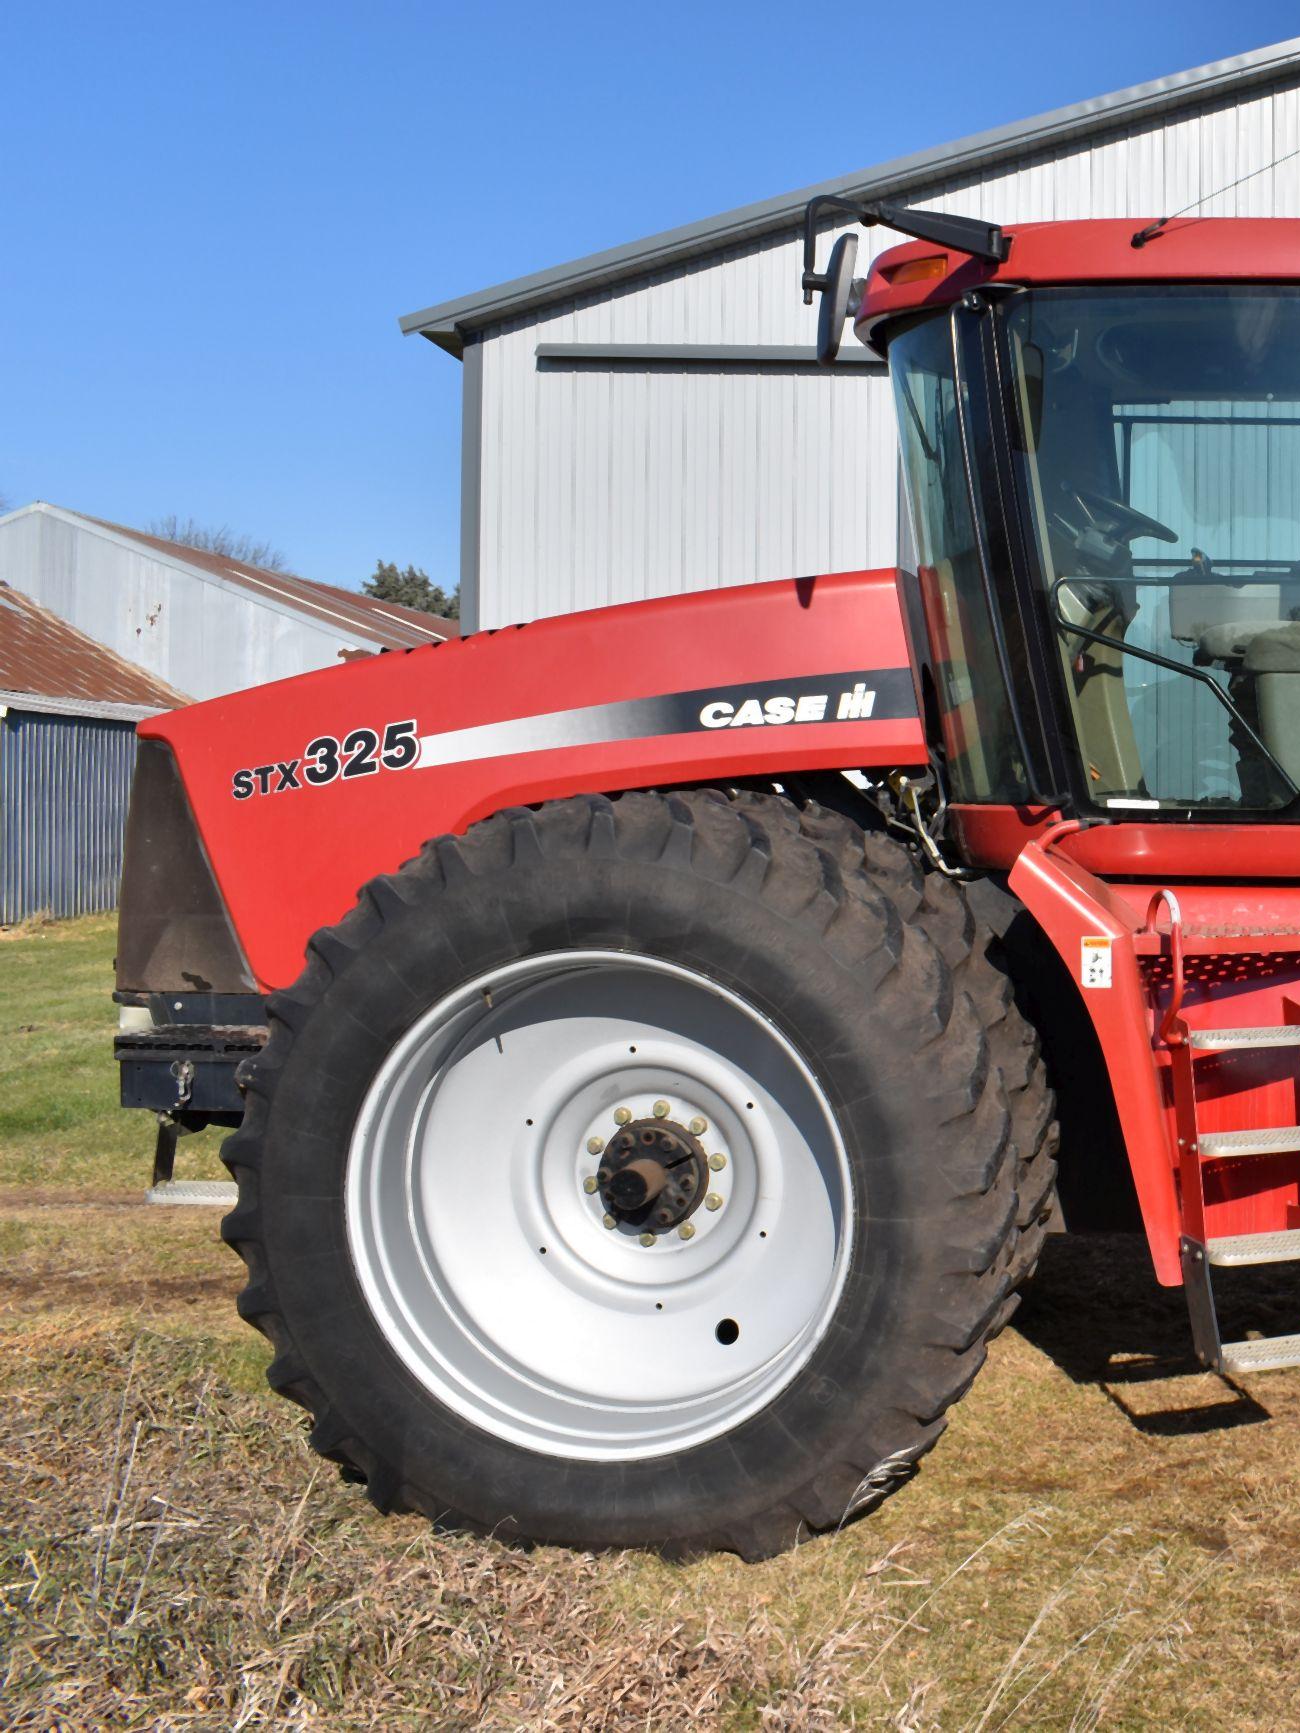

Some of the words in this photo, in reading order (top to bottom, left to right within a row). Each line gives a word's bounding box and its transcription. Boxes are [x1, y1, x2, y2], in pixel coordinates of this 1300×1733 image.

[699, 694, 829, 729] CASE
[232, 758, 302, 800] STX
[303, 719, 418, 786] 325
